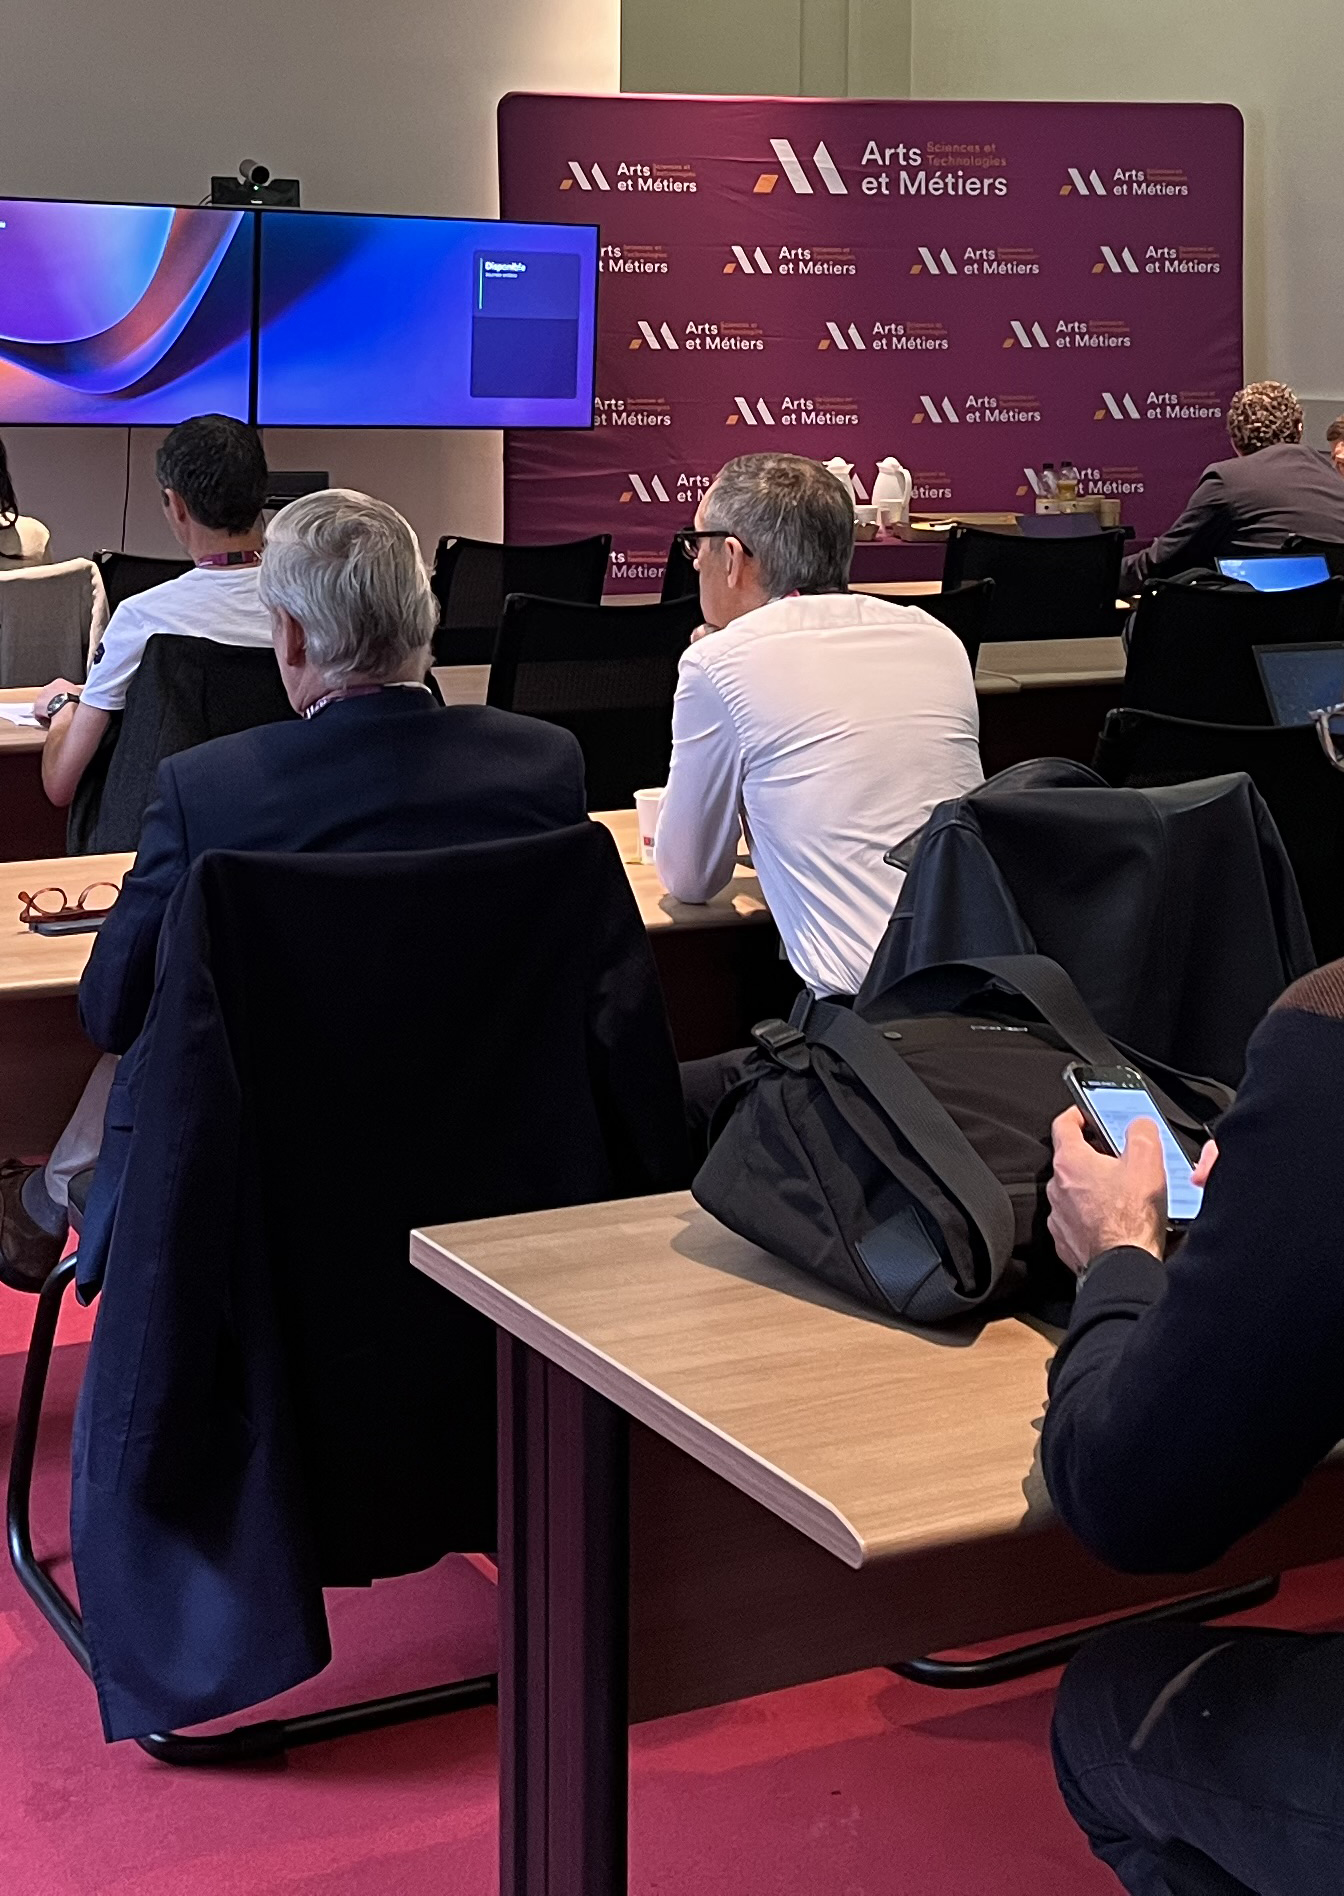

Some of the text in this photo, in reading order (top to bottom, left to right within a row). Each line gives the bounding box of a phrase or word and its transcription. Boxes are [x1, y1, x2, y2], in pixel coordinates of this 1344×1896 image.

[860, 140, 922, 166] Arts
[926, 141, 997, 153] Sciences et
[926, 154, 1007, 168] Technologies
[617, 162, 651, 177] Arts
[1113, 167, 1145, 182] Arts
[617, 178, 697, 193] et Métiers
[861, 168, 1008, 196] et Métiers
[1113, 182, 1189, 196] et Métiers
[600, 245, 622, 258] rts
[778, 246, 811, 260] Arts
[963, 247, 996, 260] Arts
[1145, 245, 1177, 259] Arts
[598, 258, 668, 274] t Métiers
[778, 260, 856, 275] et Métiers
[963, 260, 1040, 275] et Métiers
[1145, 259, 1220, 274] et Métiers
[685, 321, 718, 335] Arts
[872, 321, 905, 335] Arts
[1055, 319, 1088, 333] Arts
[685, 336, 764, 350] et Métiers
[872, 335, 949, 350] et Métiers
[1055, 333, 1131, 348] et Métiers
[594, 396, 625, 411] Arts
[781, 396, 814, 411] Arts
[965, 394, 997, 408] Arts
[1146, 391, 1178, 405] Arts
[593, 411, 672, 426] et Métiers
[781, 411, 859, 426] et Métiers
[965, 408, 1041, 423] et Métiers
[1146, 404, 1222, 419] et Métiers
[676, 473, 710, 487] Arts
[1078, 479, 1145, 495] t Métiers
[676, 489, 693, 503] et
[910, 483, 952, 499] étiers
[608, 550, 626, 564] ts
[611, 563, 666, 579] Métier
